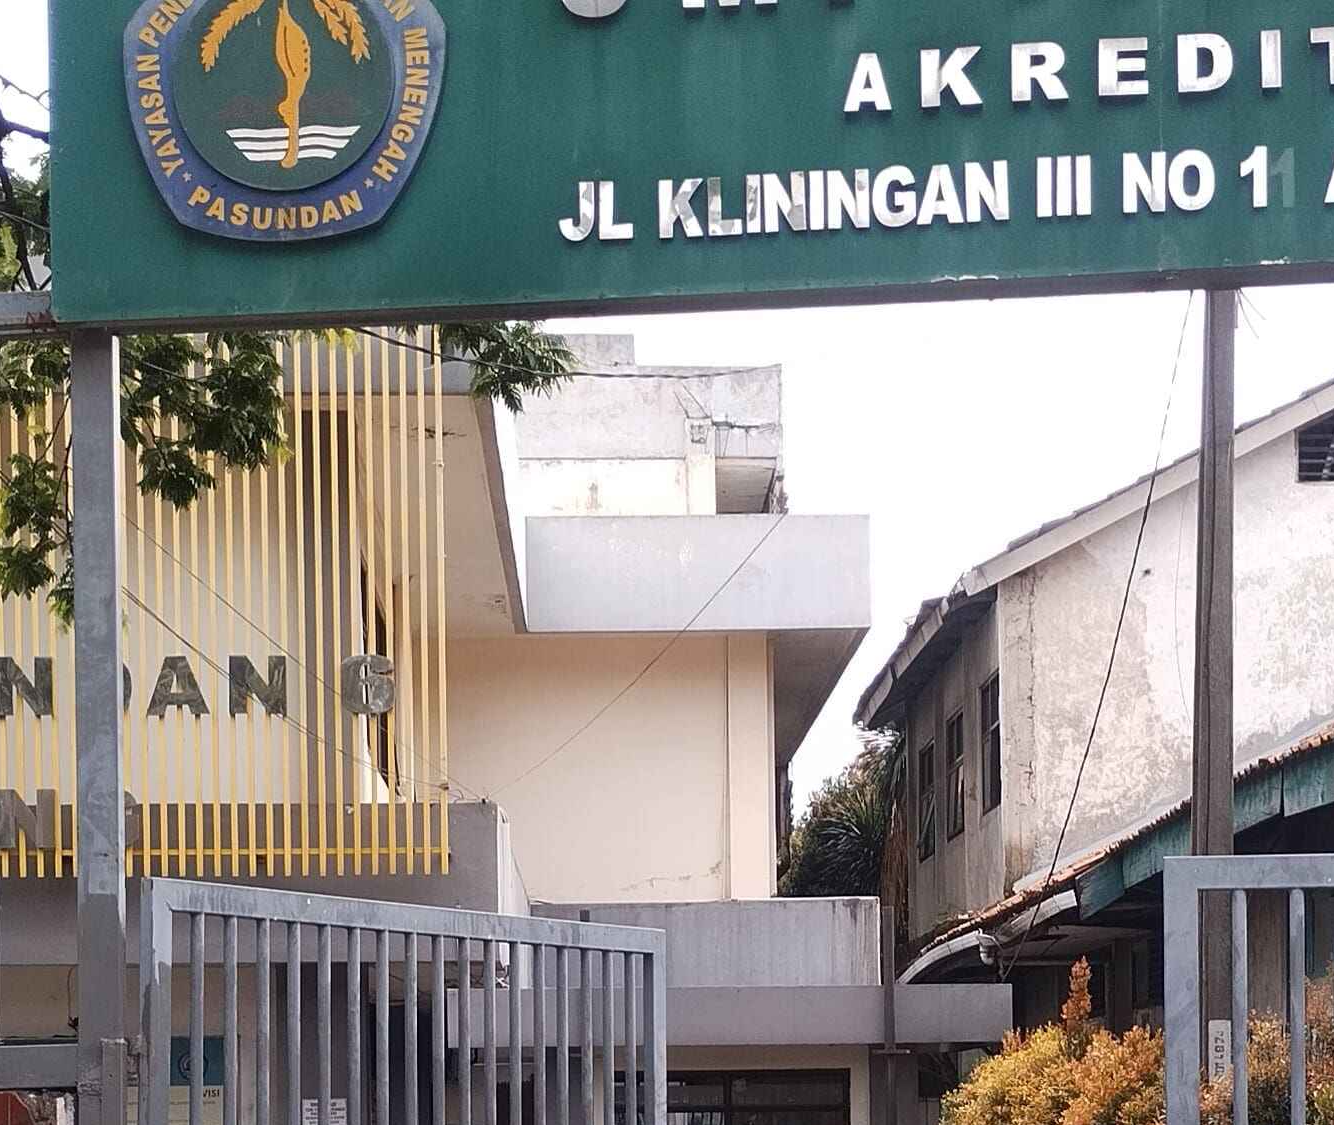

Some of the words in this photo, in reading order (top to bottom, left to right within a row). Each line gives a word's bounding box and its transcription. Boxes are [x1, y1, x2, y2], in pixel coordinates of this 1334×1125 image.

[136, 53, 185, 177] YAYASAN
[371, 27, 429, 182] MENENGAH
[187, 186, 363, 230] PASUNDAN
[558, 182, 633, 243] JL
[660, 158, 1007, 240] KLININGAN
[1123, 148, 1215, 216] NO
